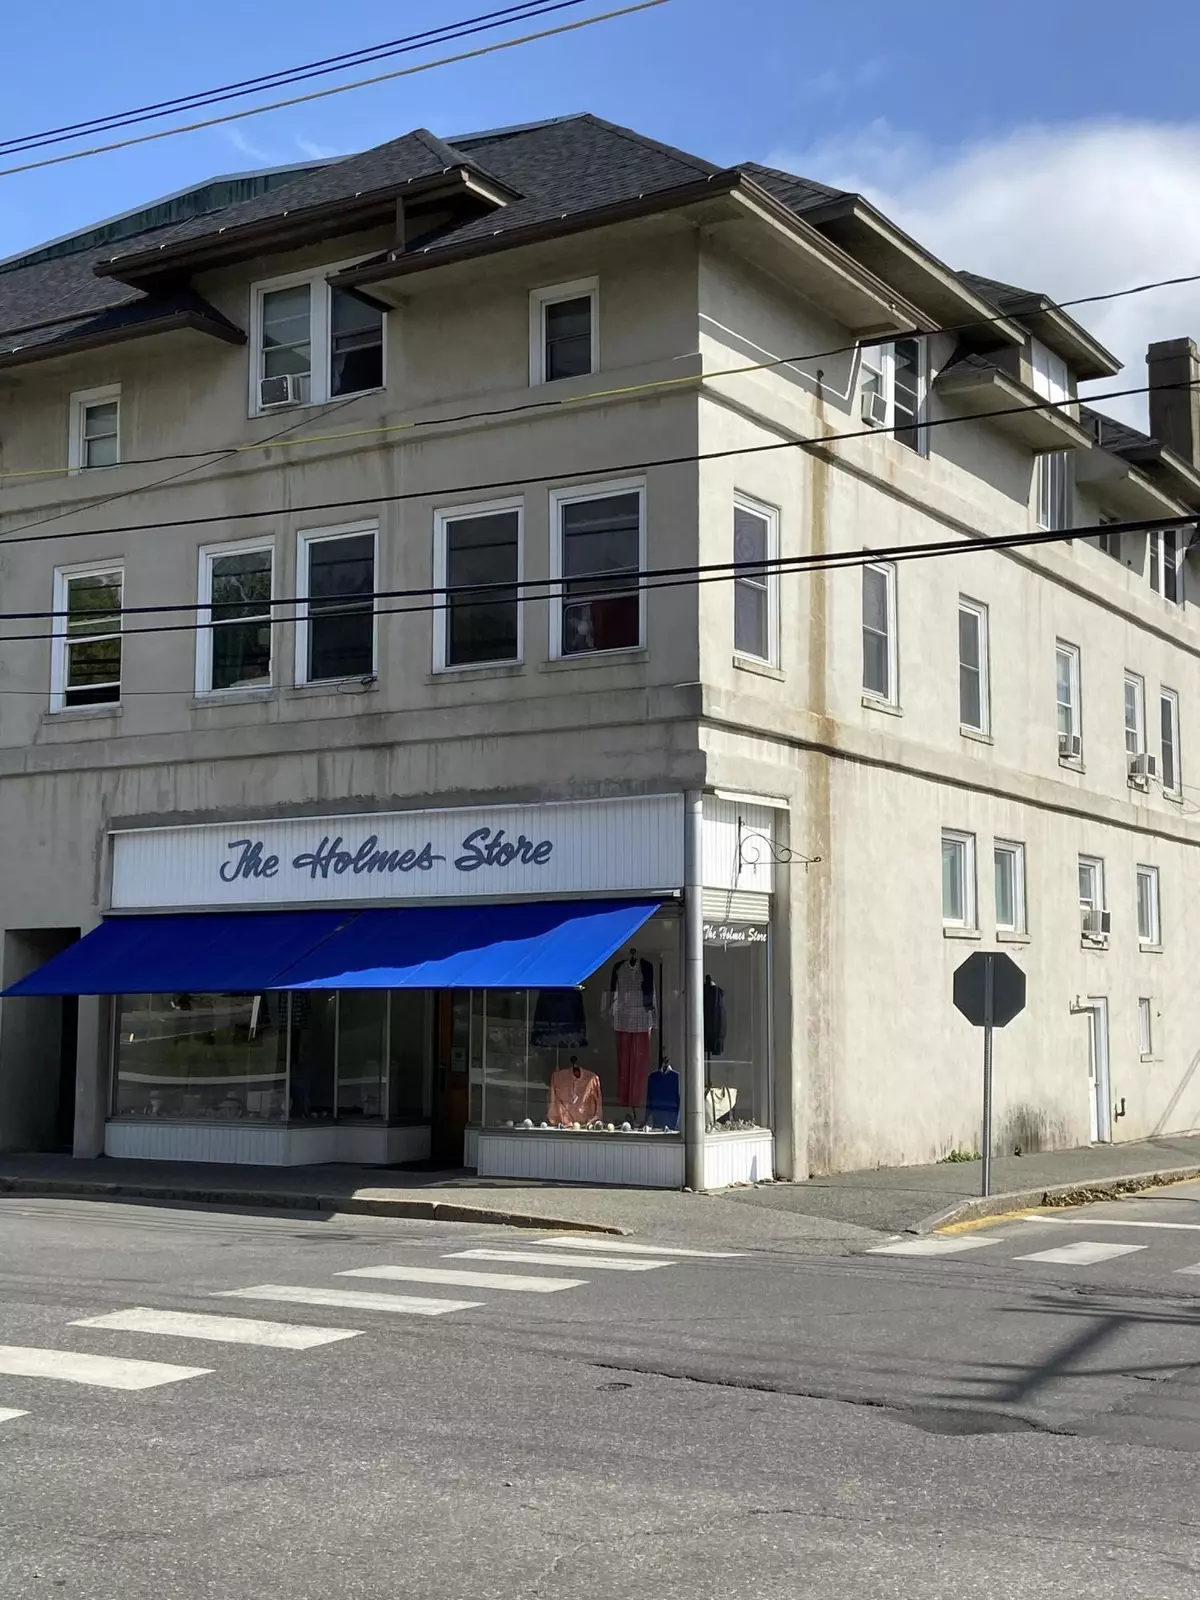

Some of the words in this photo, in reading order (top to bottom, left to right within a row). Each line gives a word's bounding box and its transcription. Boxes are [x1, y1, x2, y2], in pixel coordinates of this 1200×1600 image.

[219, 839, 279, 882] The
[293, 834, 446, 879] Holmes
[454, 827, 553, 871] Store
[703, 924, 716, 940] The
[719, 926, 745, 941] Holmes
[748, 927, 767, 942] Store
